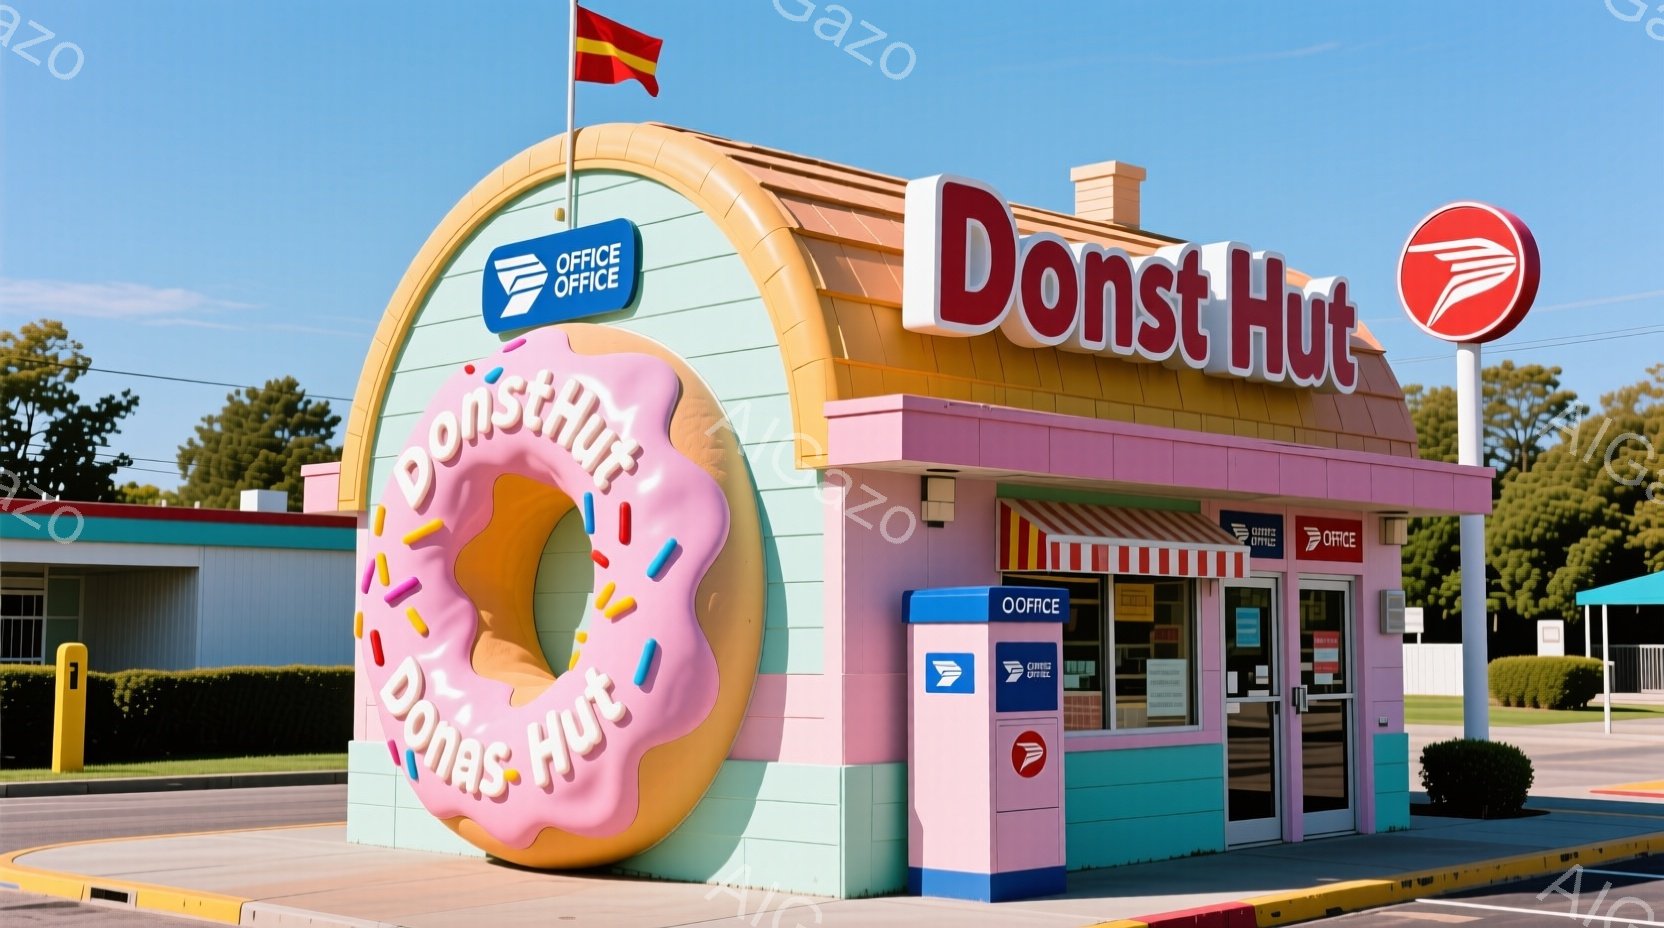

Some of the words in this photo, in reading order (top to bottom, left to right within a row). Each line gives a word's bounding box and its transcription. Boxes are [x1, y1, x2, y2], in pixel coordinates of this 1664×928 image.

[554, 266, 619, 298] OFFICE
[556, 242, 621, 274] OFFICE
[930, 175, 1211, 368] Donst
[1227, 242, 1358, 394] Hut
[526, 667, 627, 788] Hut
